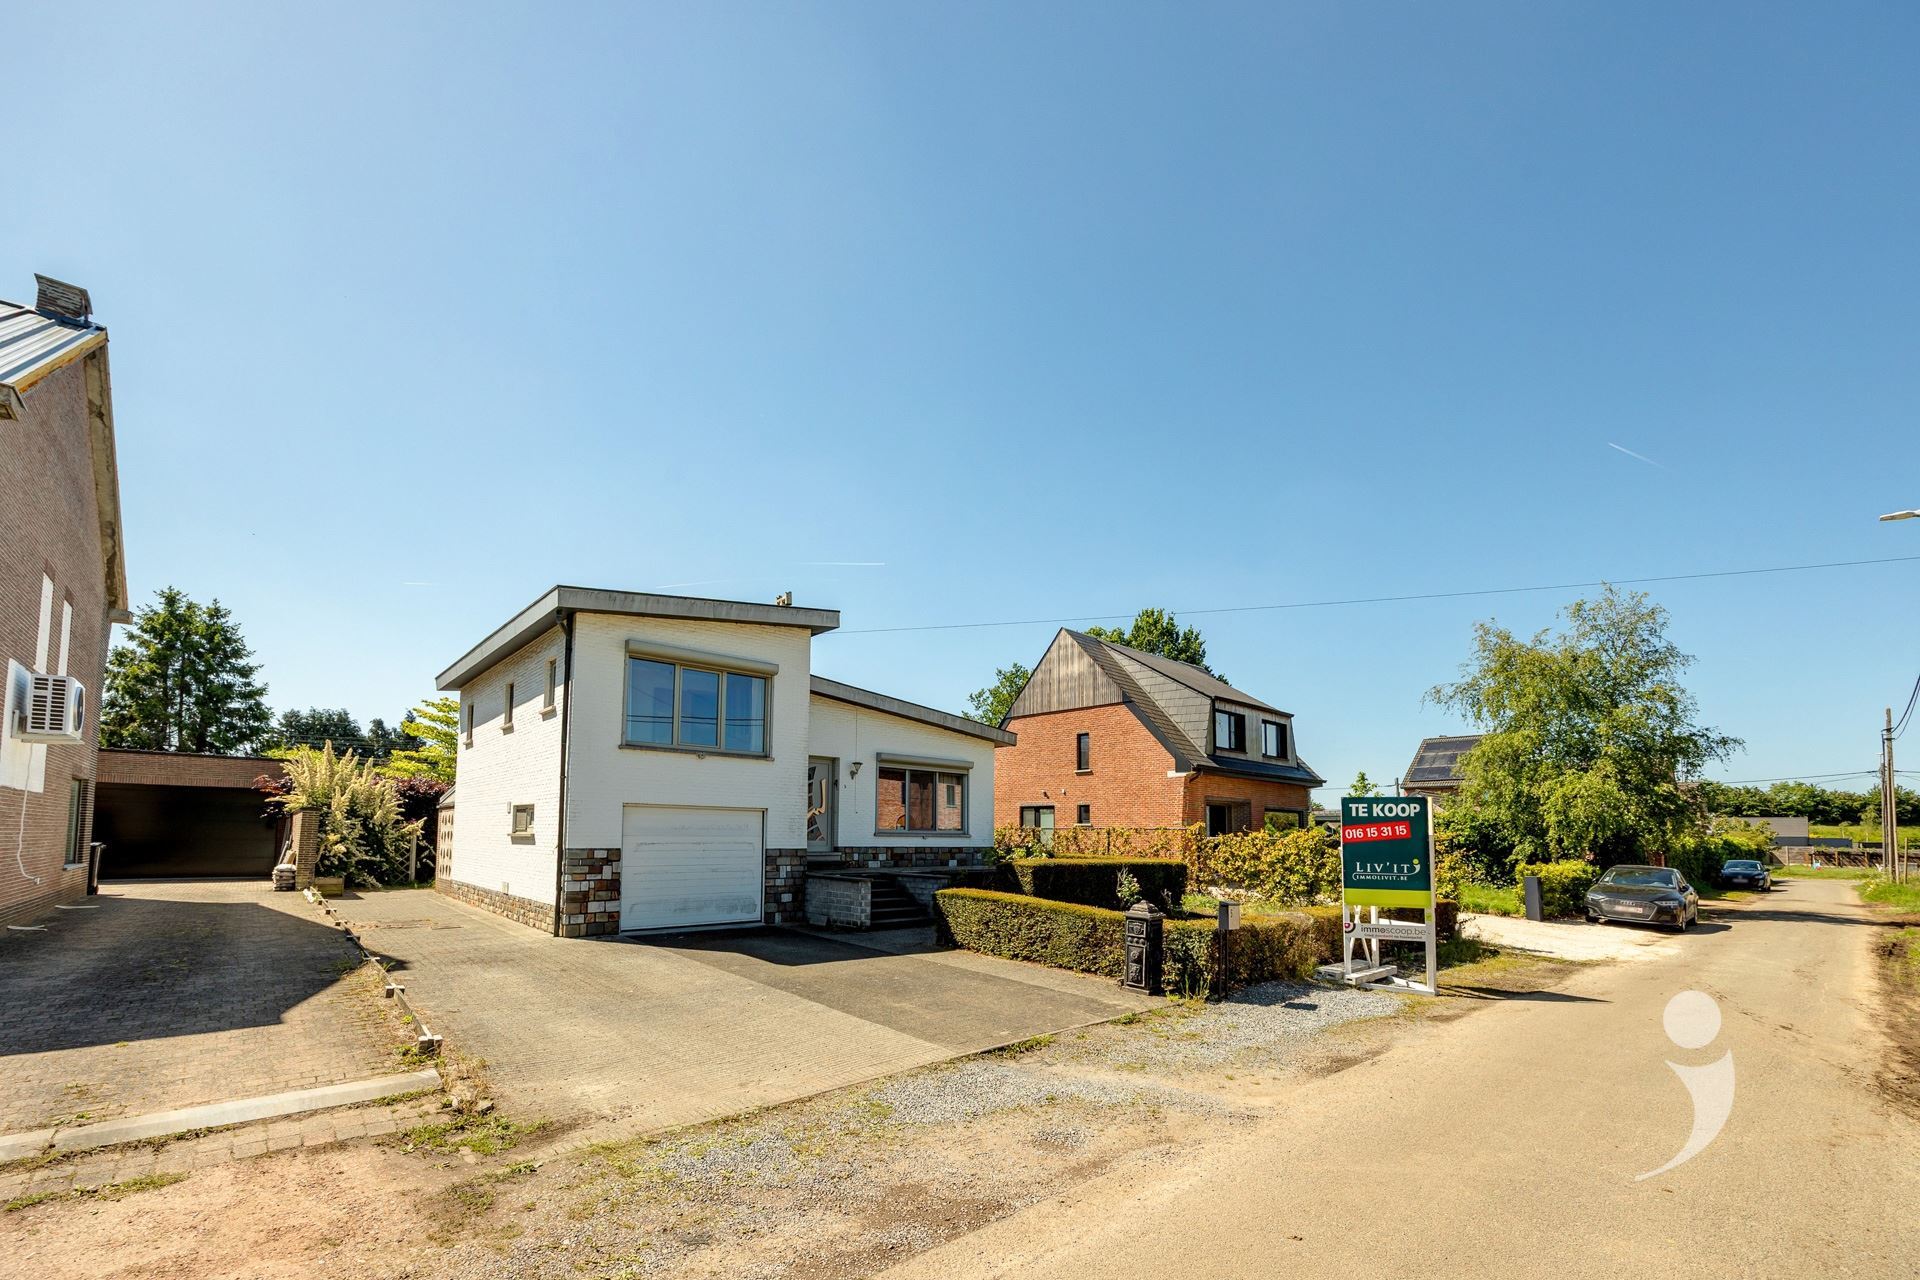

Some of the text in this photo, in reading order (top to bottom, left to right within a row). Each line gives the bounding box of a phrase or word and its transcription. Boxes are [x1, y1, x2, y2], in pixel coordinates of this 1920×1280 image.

[1349, 803, 1421, 817] TE KOOP
[1345, 825, 1407, 839] 016 15 31 15
[1360, 924, 1426, 936] immoscoop.be
